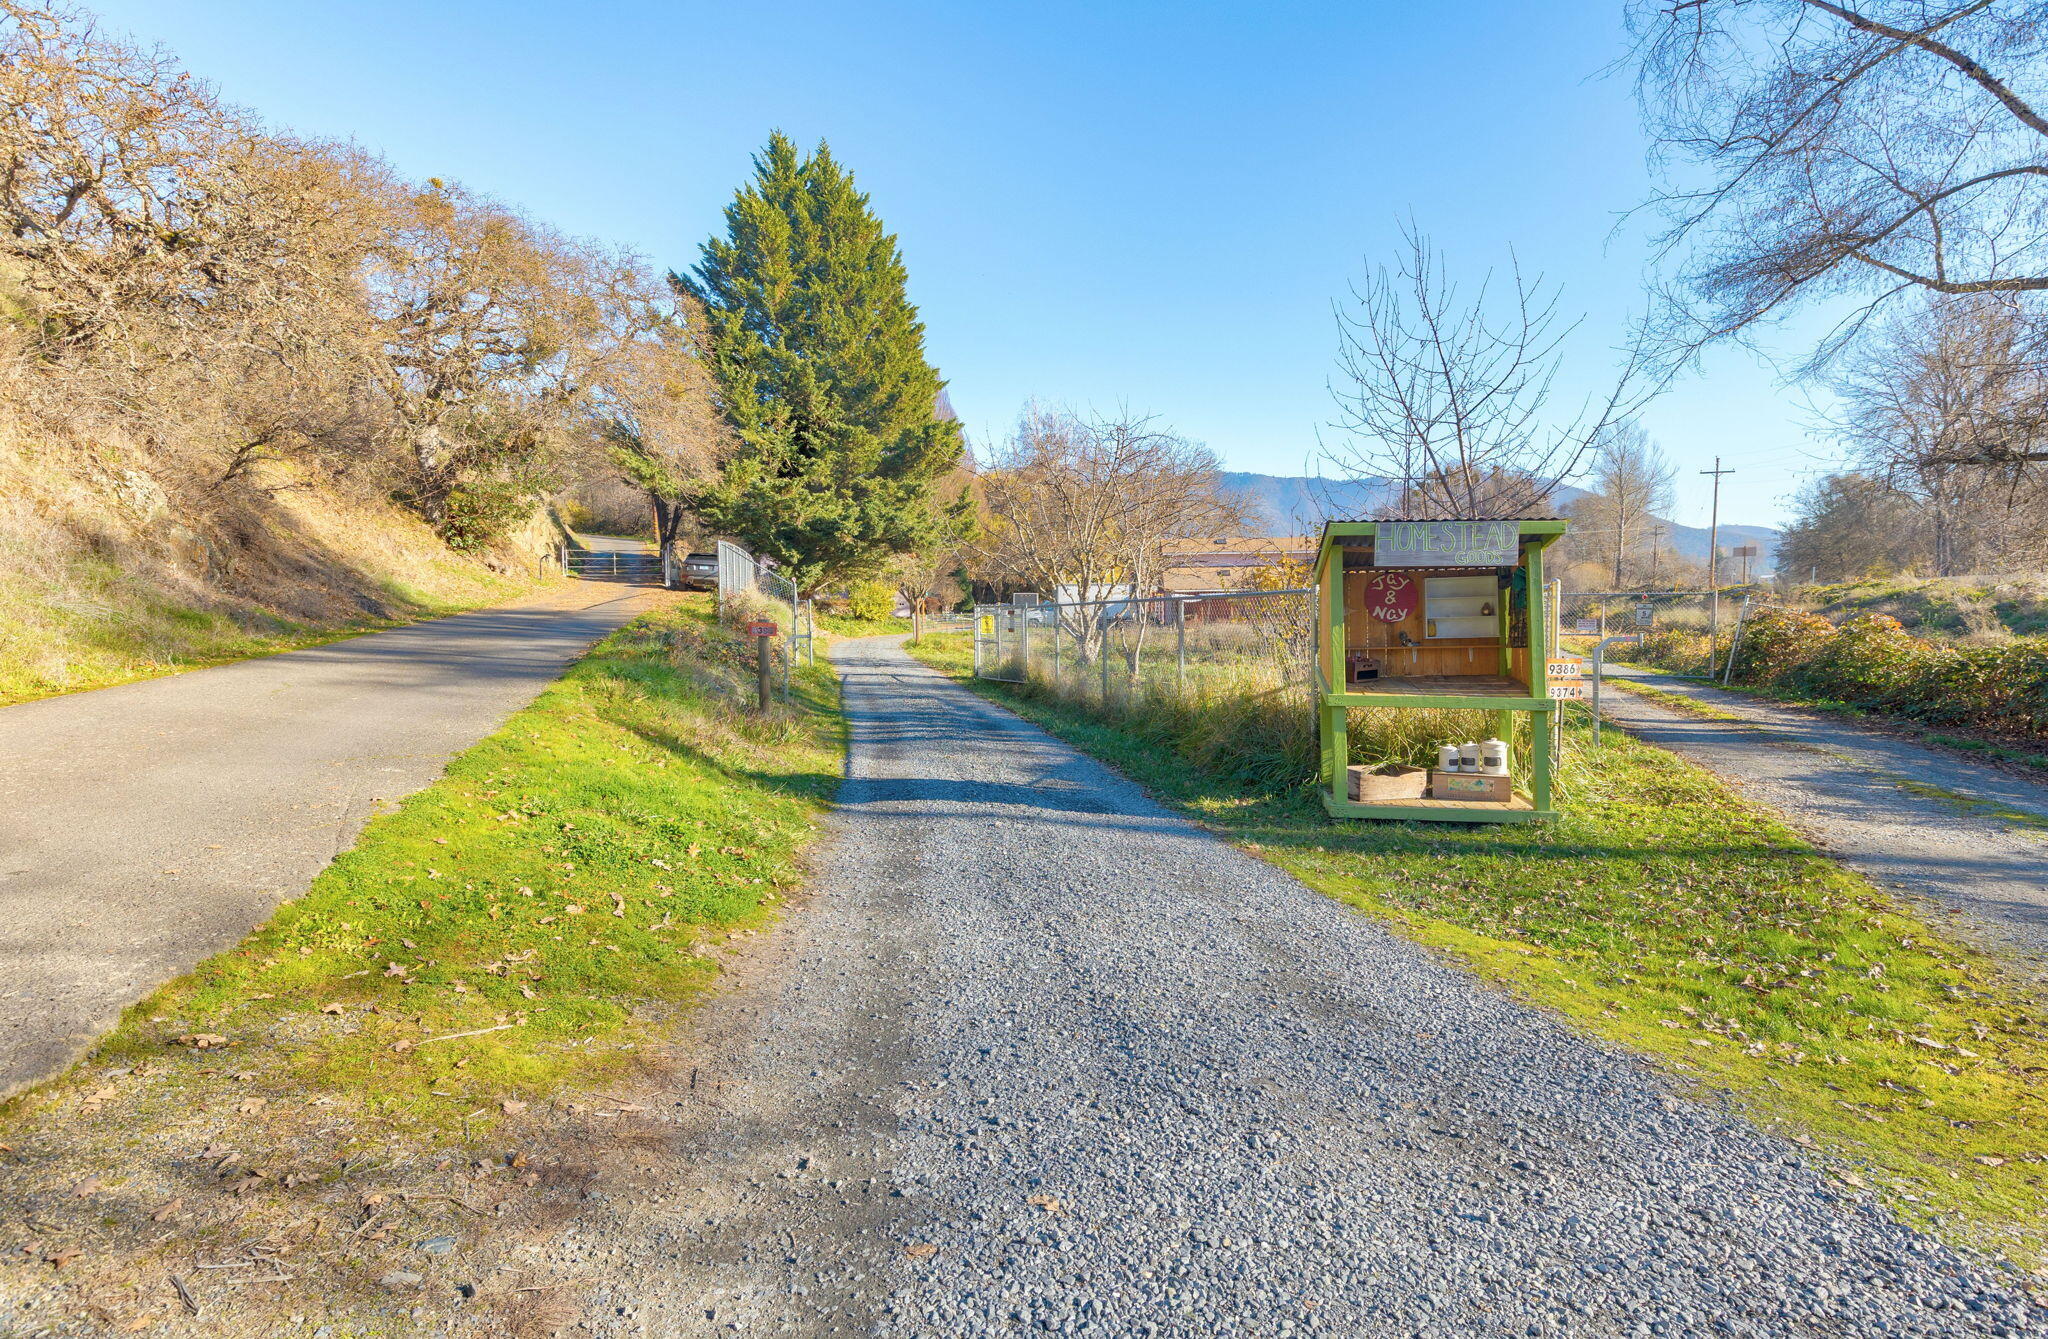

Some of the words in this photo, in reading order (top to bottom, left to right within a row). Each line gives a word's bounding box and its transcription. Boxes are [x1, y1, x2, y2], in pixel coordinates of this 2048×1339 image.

[1376, 522, 1517, 552] HOMESTEAD
[1455, 550, 1504, 564] GOODS
[1384, 590, 1397, 605] &
[1549, 664, 1576, 675] 9386
[1550, 687, 1576, 698] 9374
